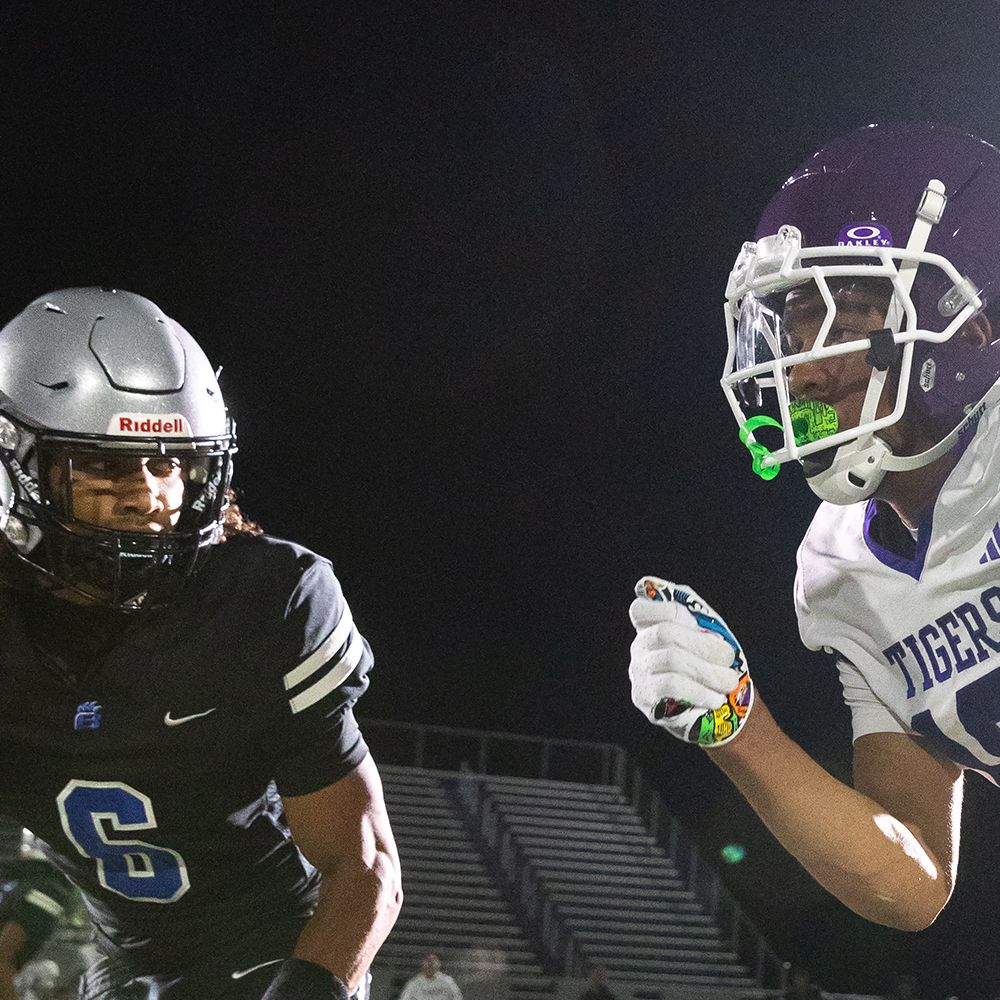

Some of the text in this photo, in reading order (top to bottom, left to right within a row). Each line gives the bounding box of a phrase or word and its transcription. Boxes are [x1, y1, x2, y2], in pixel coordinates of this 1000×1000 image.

[838, 239, 887, 247] OAKLEY
[119, 417, 183, 433] Riddell
[56, 779, 190, 904] 6
